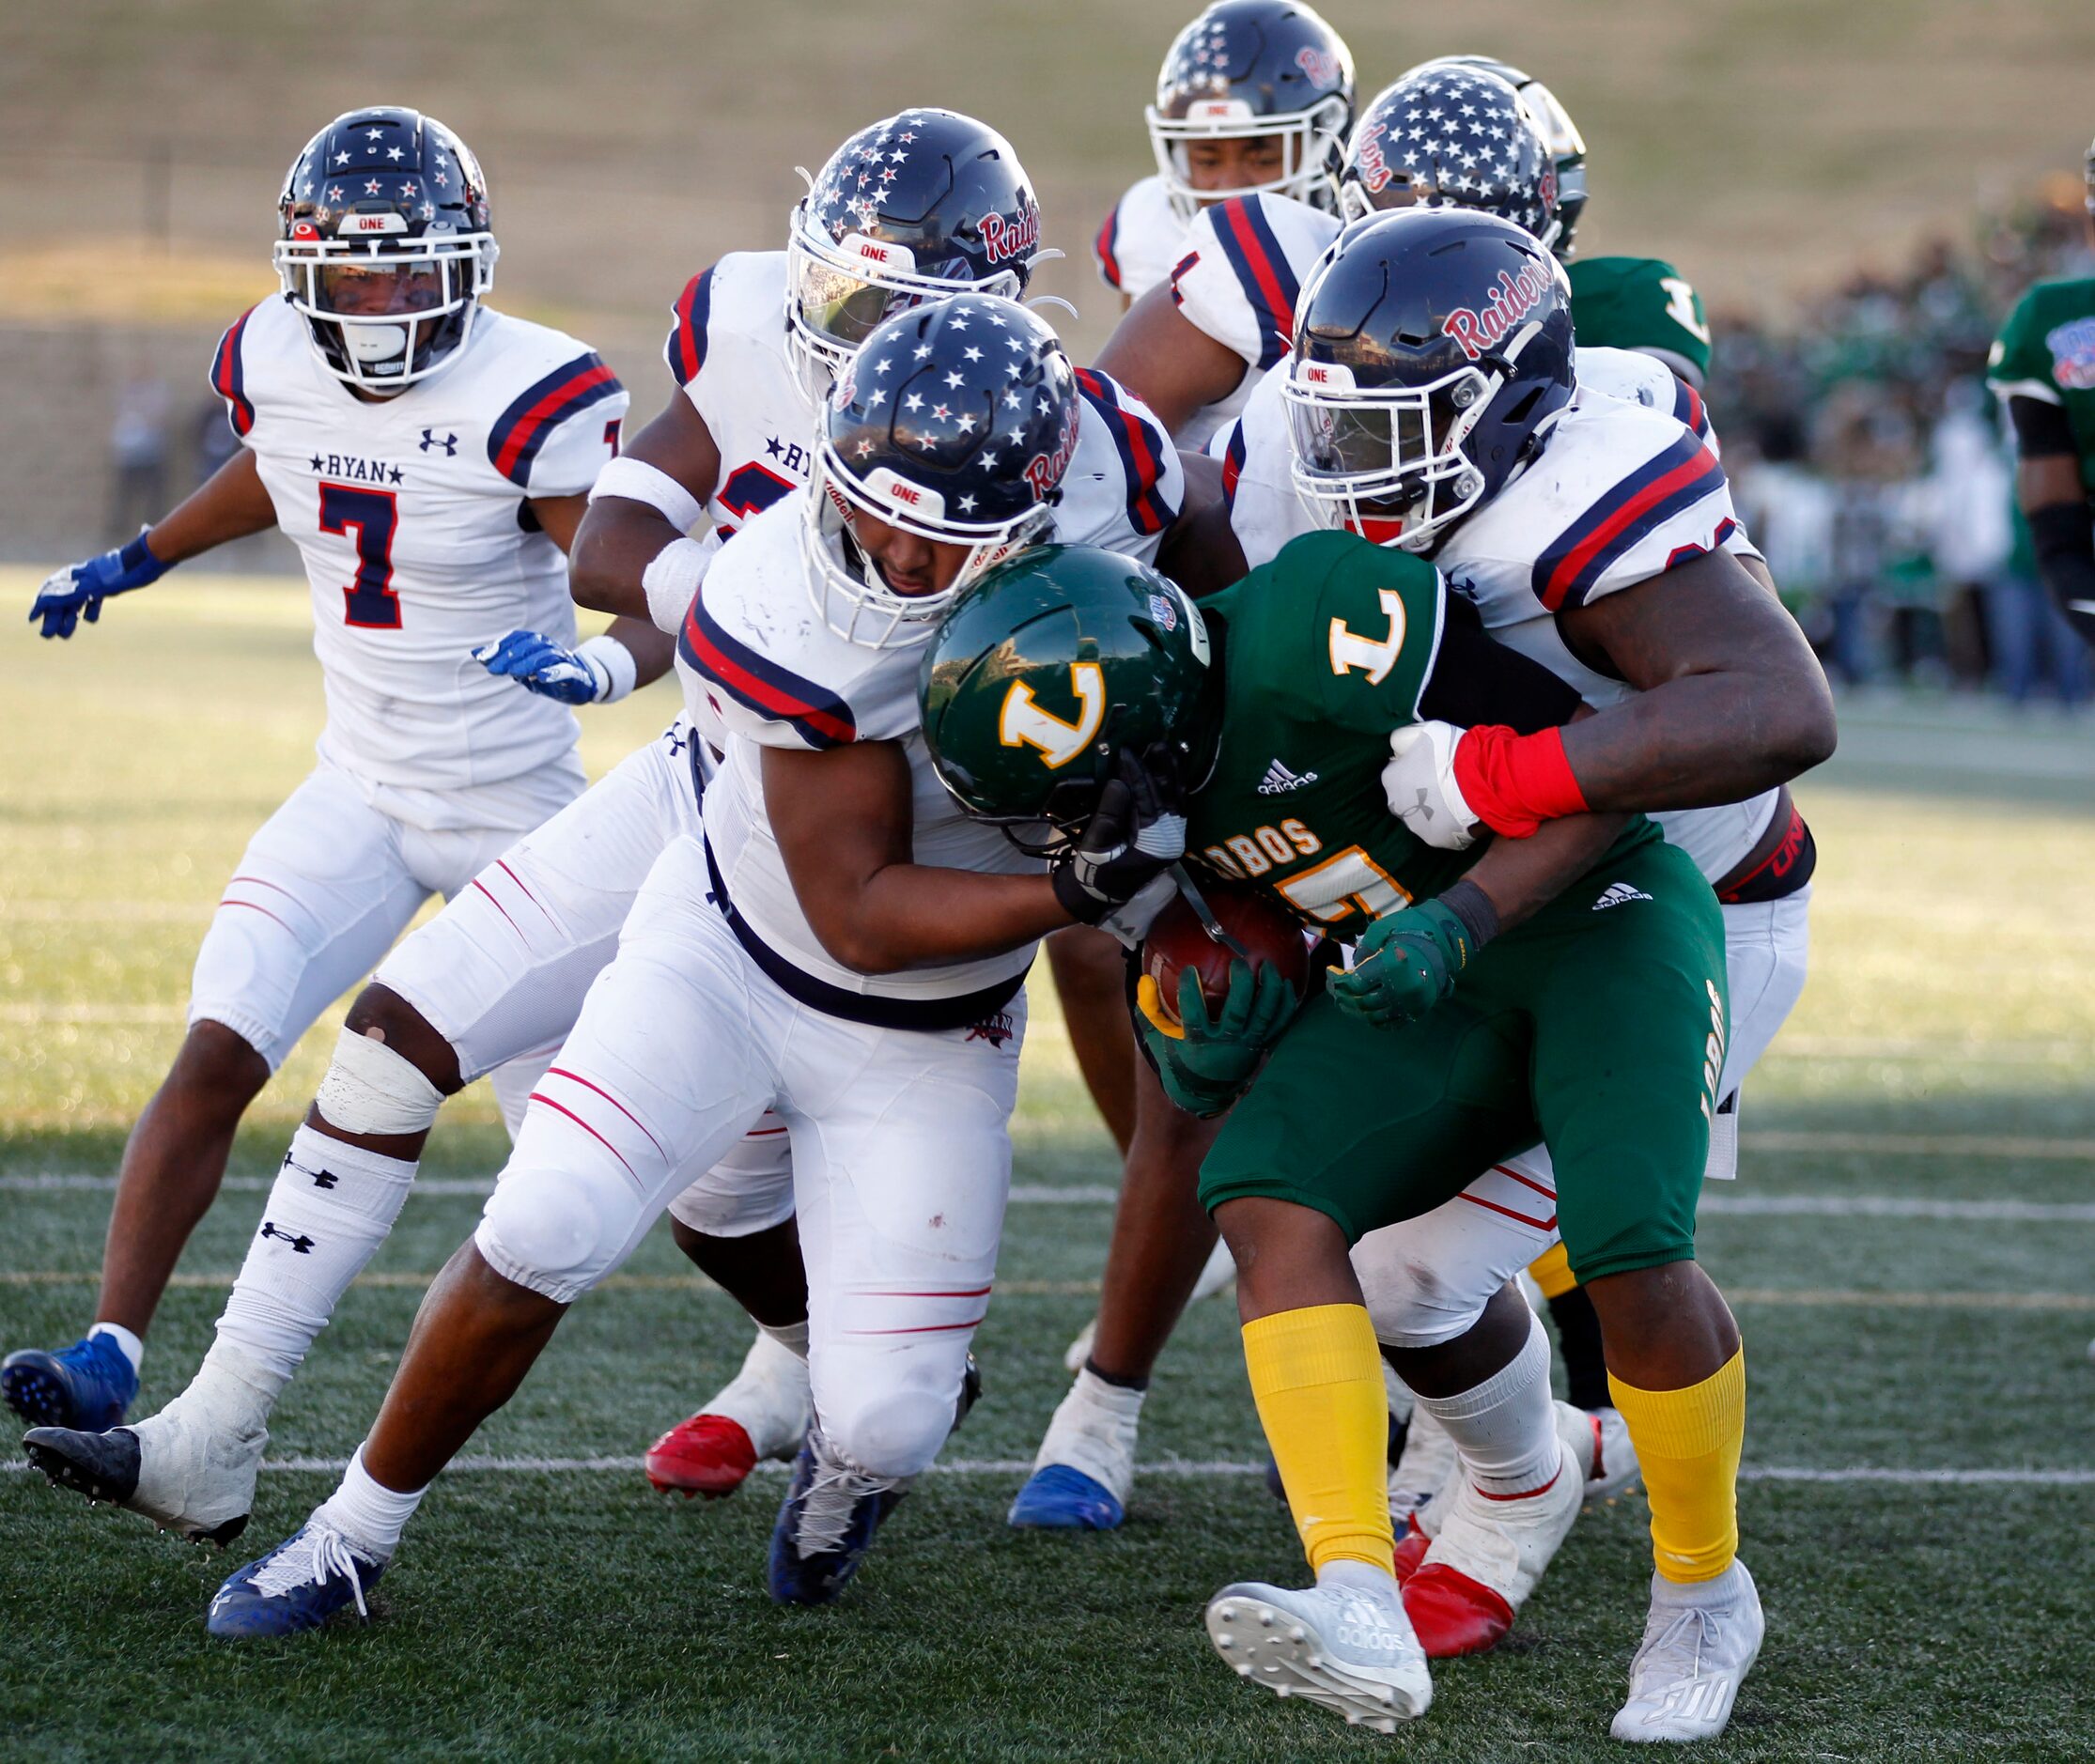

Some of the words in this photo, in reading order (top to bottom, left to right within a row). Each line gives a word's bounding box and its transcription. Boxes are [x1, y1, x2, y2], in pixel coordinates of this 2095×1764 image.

[359, 218, 384, 230] ONE
[861, 245, 888, 262] ONE
[1441, 258, 1553, 361] Raiders
[1307, 367, 1327, 382] ONE
[328, 454, 387, 483] RYAN
[892, 482, 922, 506] ONE
[318, 481, 403, 630] 7
[1328, 587, 1407, 688] L
[998, 661, 1107, 770] L
[1257, 770, 1318, 795] adidas
[1591, 892, 1653, 910] adidas
[1337, 1625, 1404, 1650] adidas
